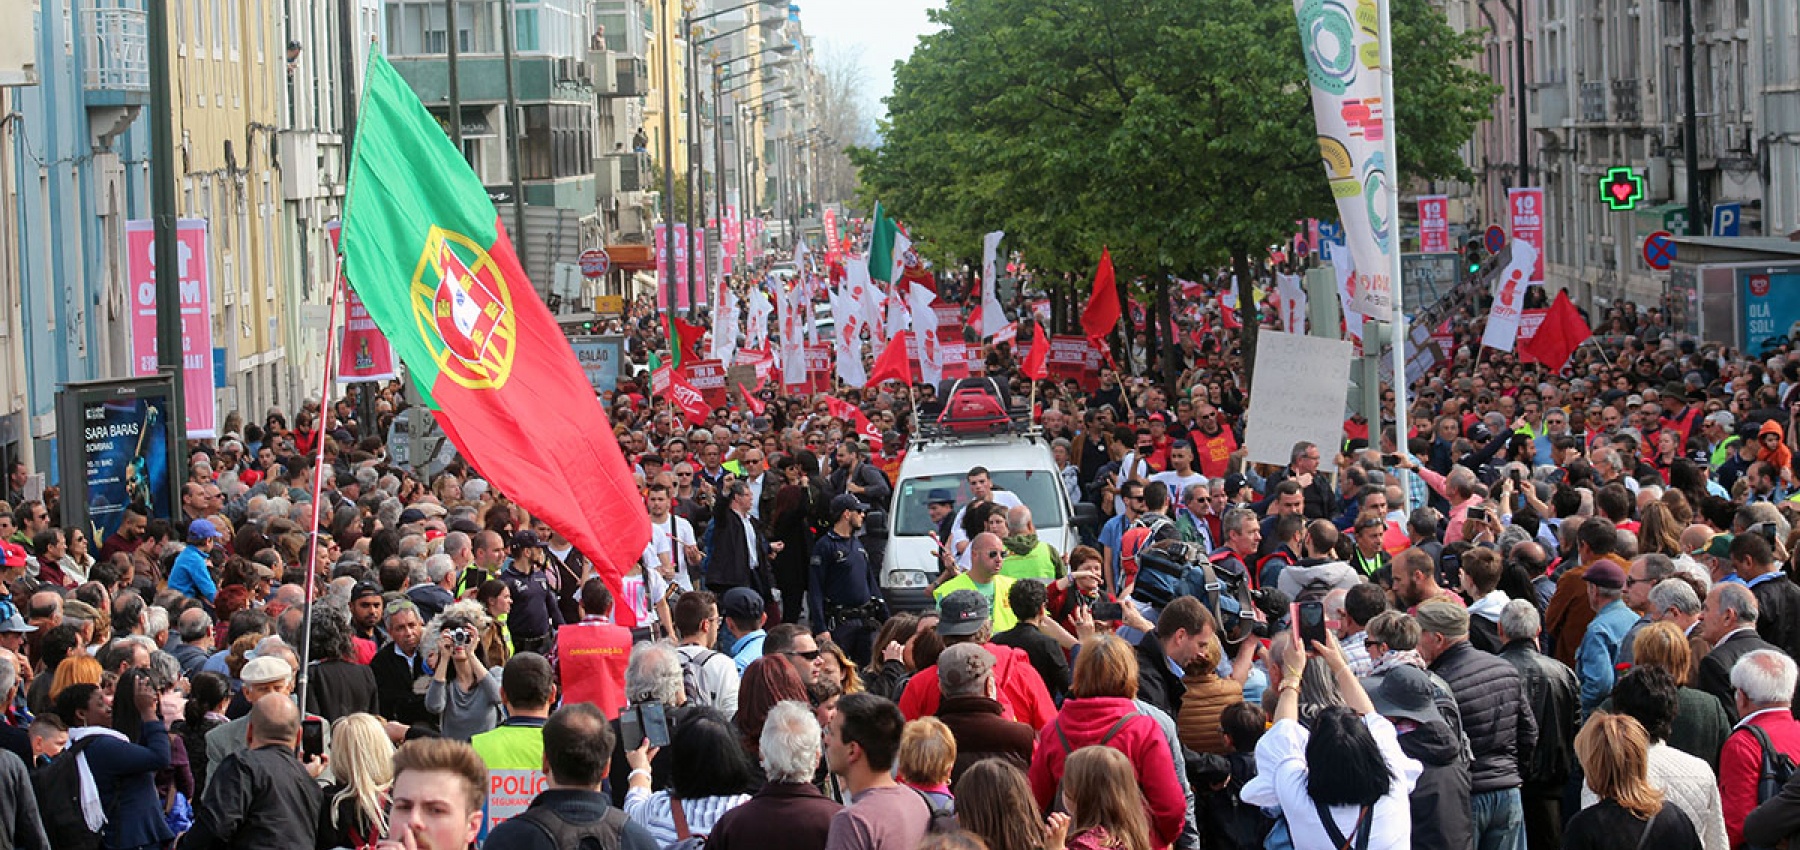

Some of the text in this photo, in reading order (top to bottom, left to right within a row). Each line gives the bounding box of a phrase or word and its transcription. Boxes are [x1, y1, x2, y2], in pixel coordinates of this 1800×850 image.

[1513, 215, 1541, 225] MAIO
[1719, 209, 1734, 235] P
[1749, 302, 1770, 317] OLÁ
[1750, 319, 1774, 333] SOL!
[579, 348, 608, 361] GALÃO
[85, 423, 138, 440] SARA BARAS
[570, 647, 623, 656] ORGANIZAÇÃO
[491, 770, 547, 796] POLÍC
